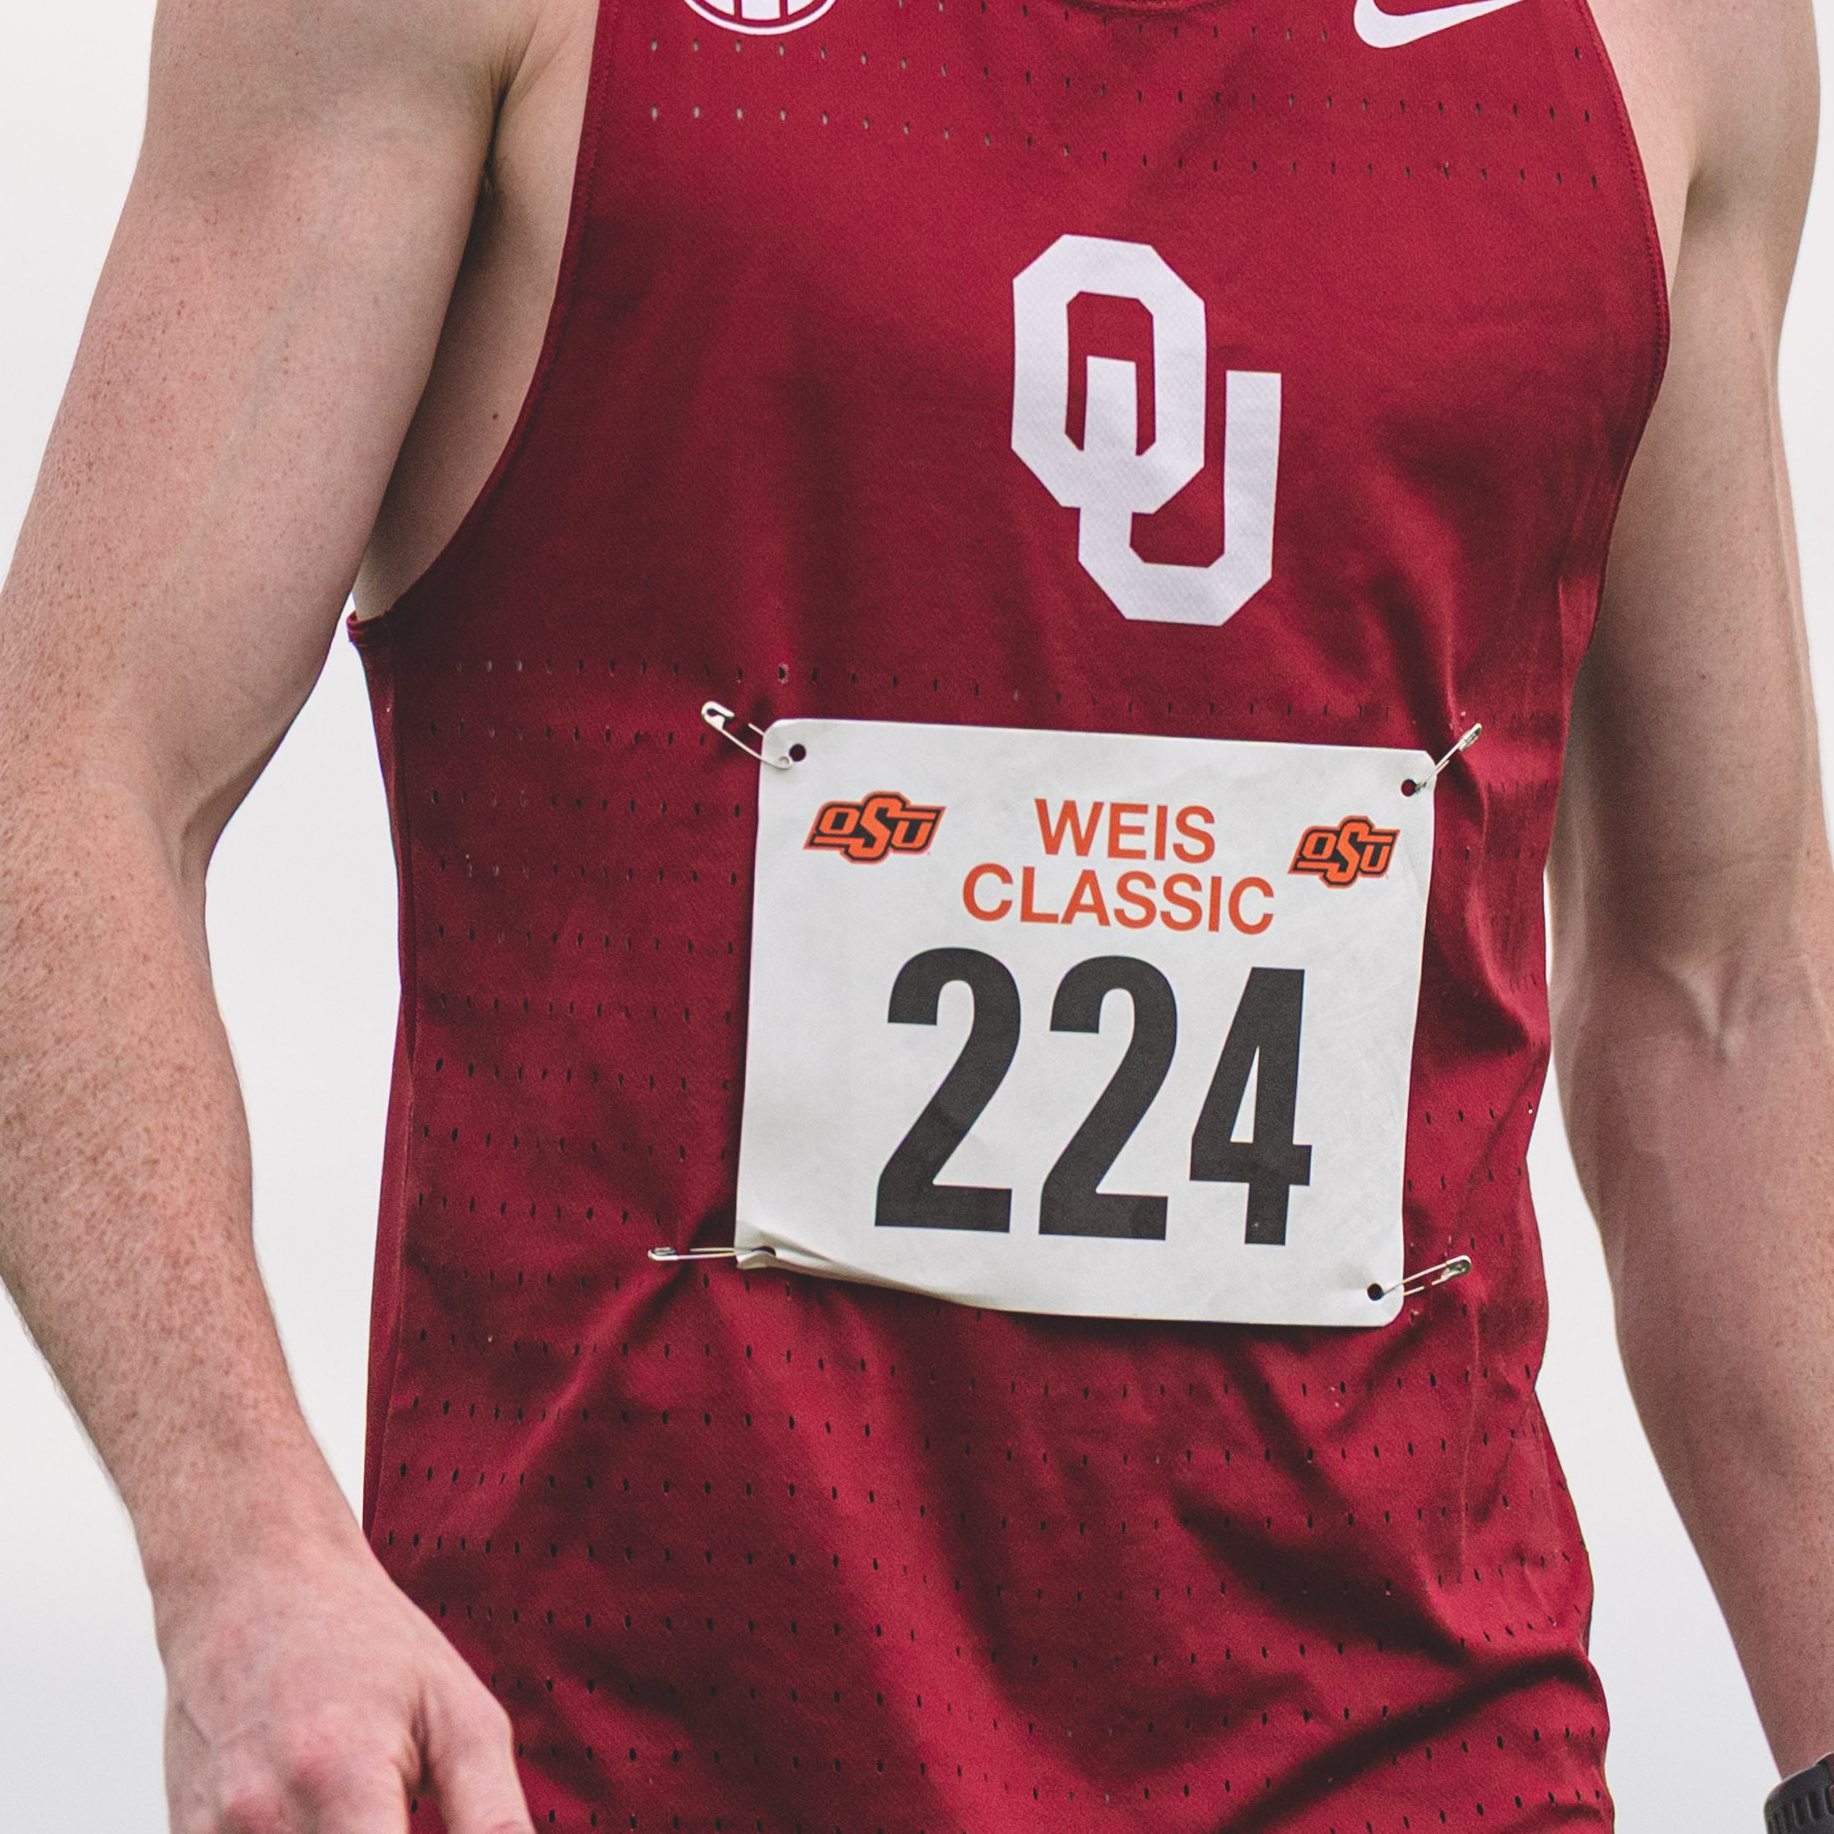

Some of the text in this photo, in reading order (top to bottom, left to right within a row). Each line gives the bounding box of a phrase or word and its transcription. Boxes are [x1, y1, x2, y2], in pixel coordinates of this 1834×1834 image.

[1011, 233, 1282, 625] OU
[804, 791, 945, 863] OSU
[1035, 799, 1216, 863] WEIS
[1289, 816, 1400, 888] OSU
[963, 863, 1275, 934] CLASSIC
[874, 946, 1313, 1246] 224
